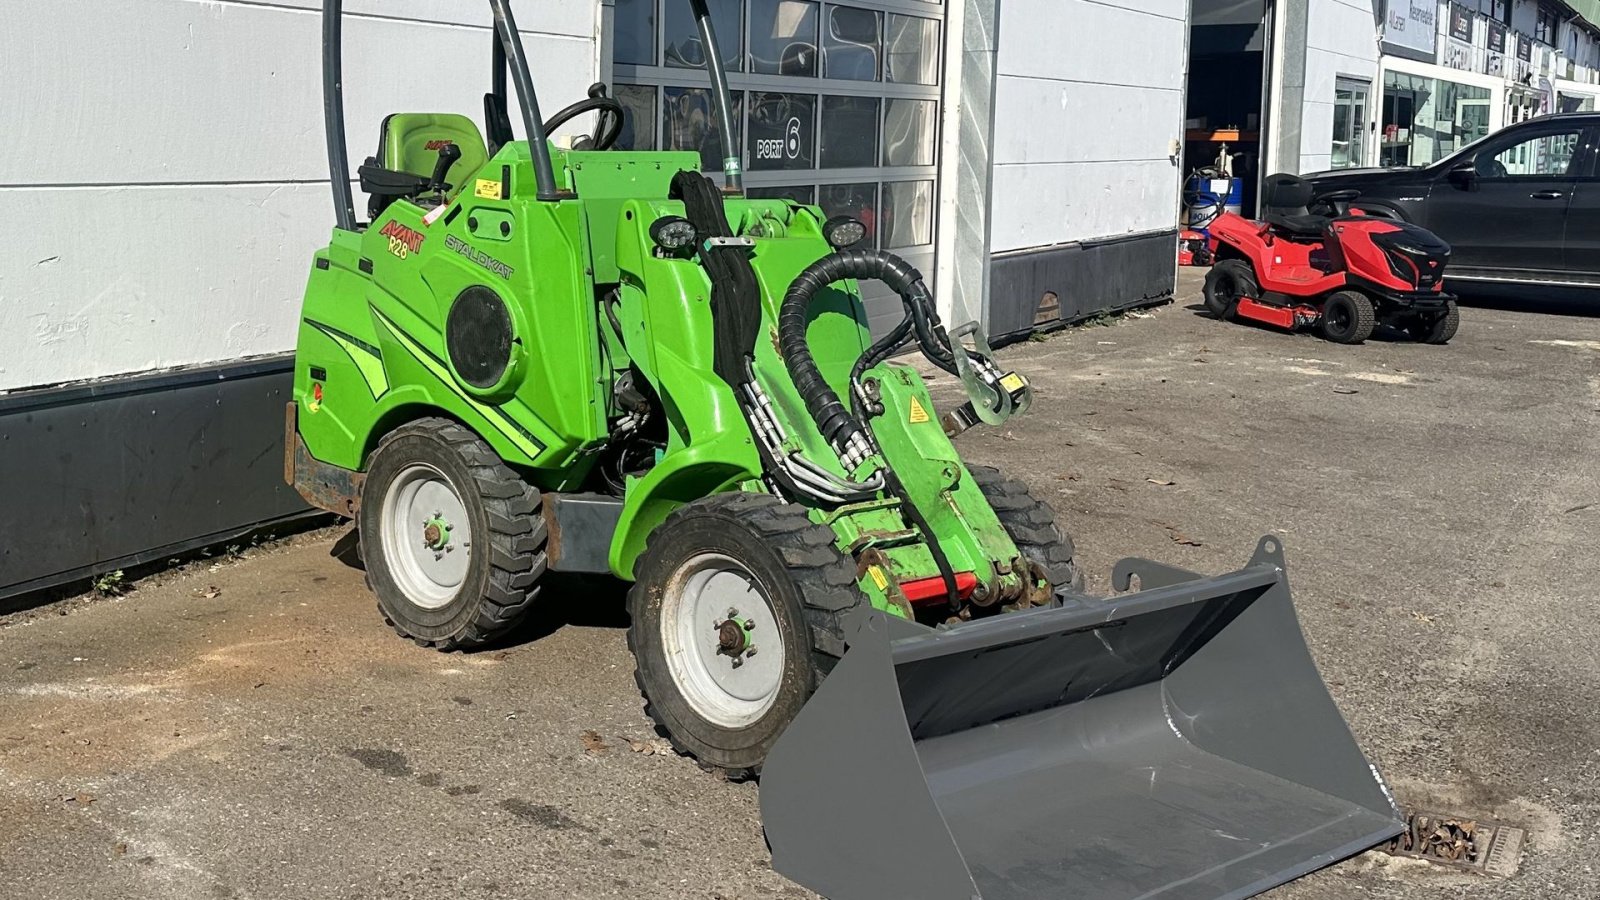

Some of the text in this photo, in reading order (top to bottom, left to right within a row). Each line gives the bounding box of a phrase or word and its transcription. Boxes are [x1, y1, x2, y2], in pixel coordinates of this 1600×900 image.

[757, 117, 801, 159] PORT 6
[379, 219, 425, 255] AVANT
[388, 236, 408, 260] R28
[445, 234, 514, 281] STALDKAT
